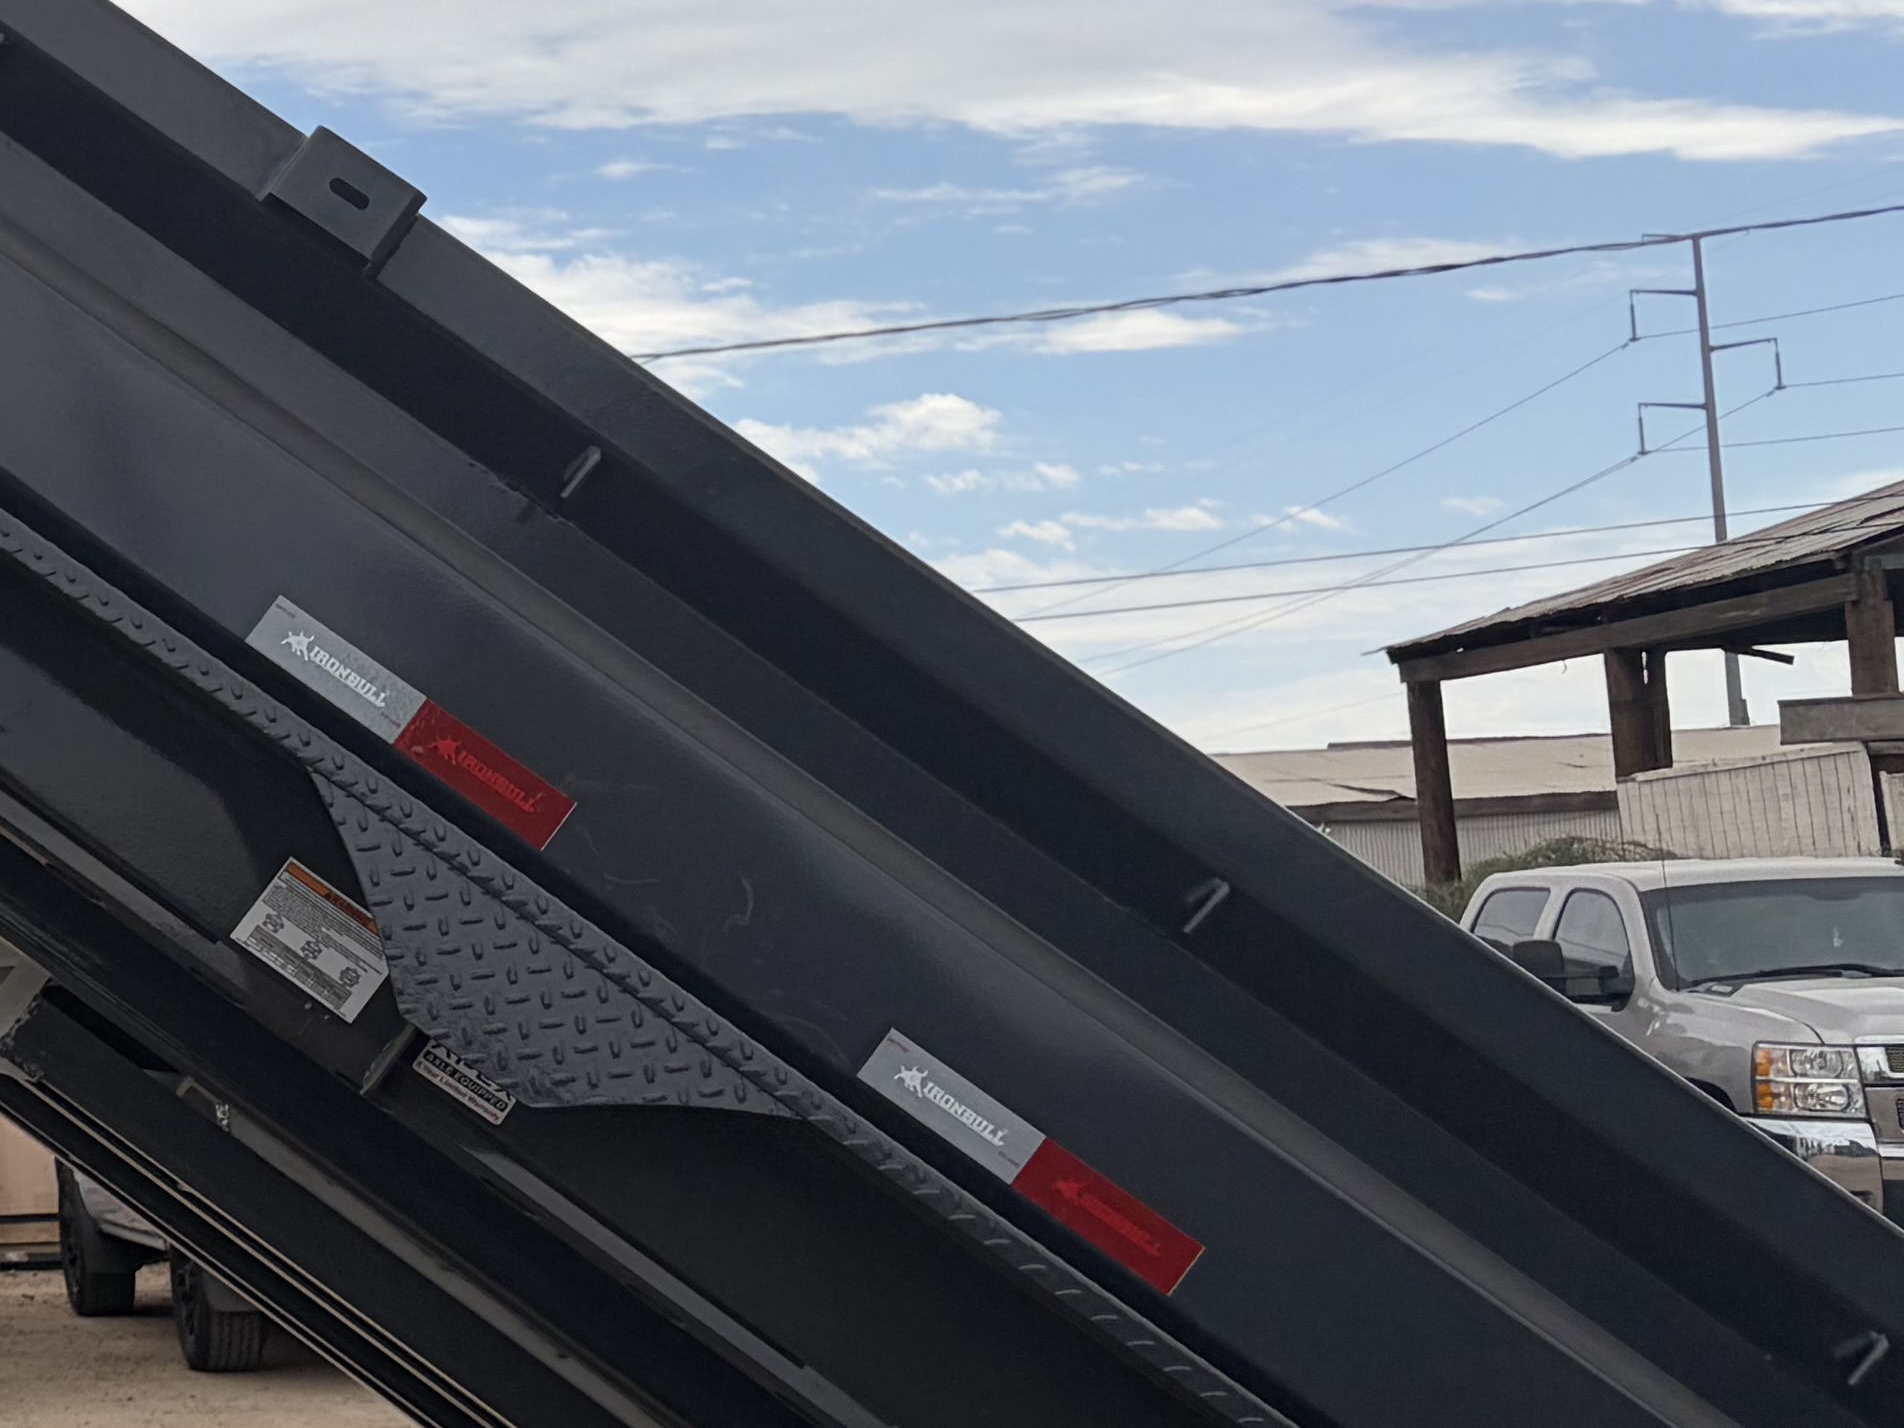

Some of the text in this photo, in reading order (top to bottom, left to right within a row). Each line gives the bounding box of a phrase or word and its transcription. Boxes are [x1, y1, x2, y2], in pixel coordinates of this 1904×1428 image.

[310, 645, 388, 708] IRONBULL
[456, 750, 539, 813] IRONBULL
[423, 1051, 454, 1076] AXLE
[451, 1070, 507, 1111] EQUIPPED
[923, 1080, 1006, 1147] IRONBULL
